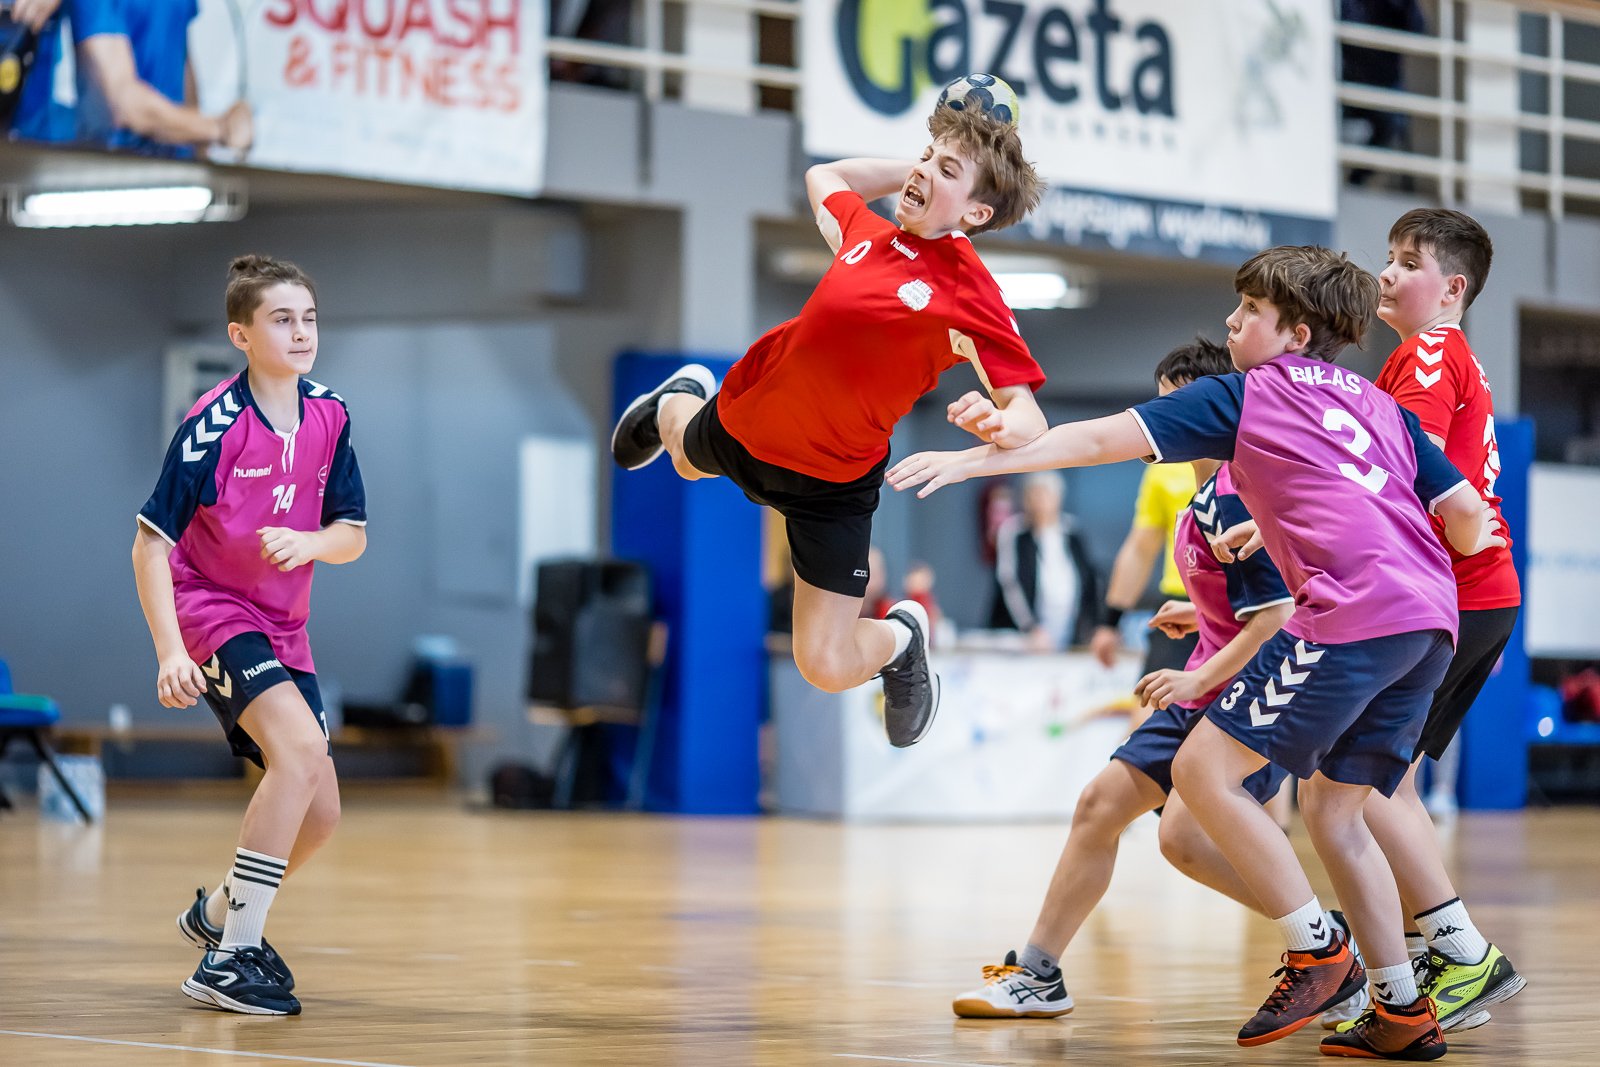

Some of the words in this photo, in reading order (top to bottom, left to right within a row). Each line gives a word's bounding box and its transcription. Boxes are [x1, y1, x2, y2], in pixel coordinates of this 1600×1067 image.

[836, 0, 1177, 118] Gazeta
[284, 35, 319, 88] &
[331, 42, 519, 114] FITNESS
[890, 236, 919, 260] hummel
[1287, 365, 1363, 395] BIŁAS
[1322, 408, 1389, 495] 3
[233, 464, 273, 478] hummel
[272, 484, 297, 515] 14
[1220, 681, 1246, 711] 3
